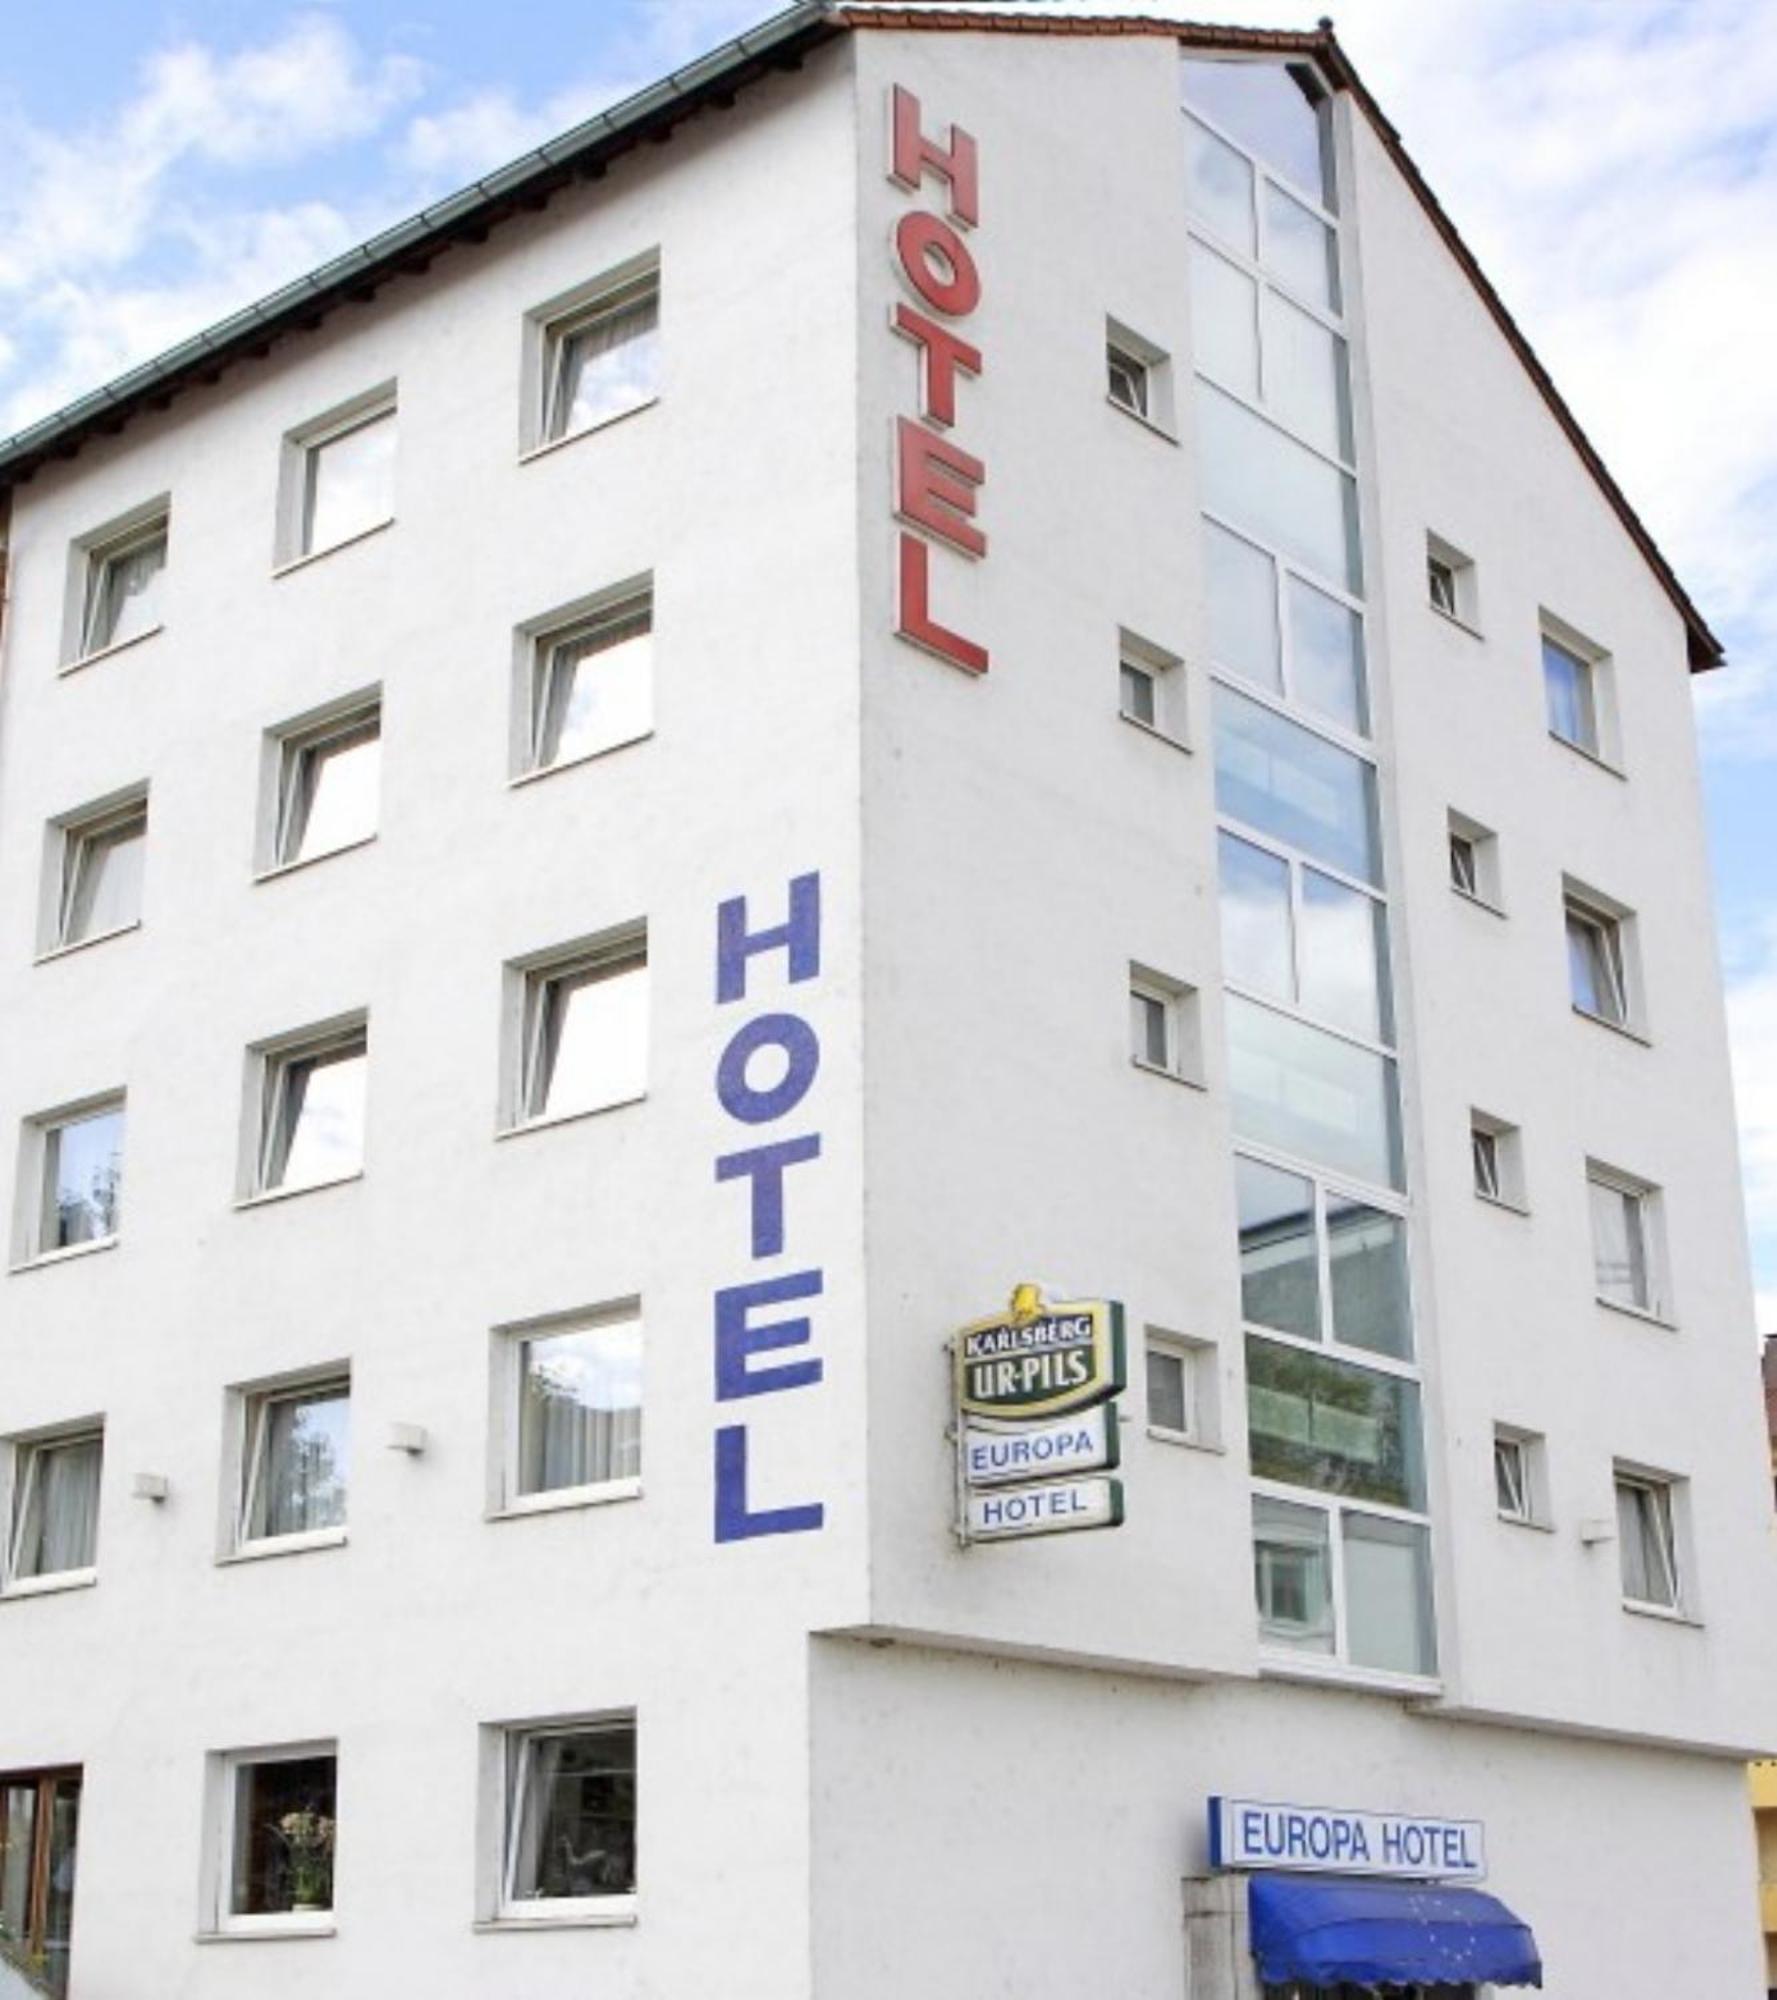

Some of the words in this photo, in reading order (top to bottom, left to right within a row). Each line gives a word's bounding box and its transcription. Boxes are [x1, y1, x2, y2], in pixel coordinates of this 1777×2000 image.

[888, 83, 989, 677] HOTEL
[714, 870, 823, 1543] HOTEL
[966, 1316, 1091, 1356] KARLSBERG
[973, 1350, 1088, 1398] UR-PILS
[971, 1431, 1094, 1470] EUROPA
[983, 1489, 1087, 1524] HOTEL
[1243, 1810, 1370, 1862] EUROPA
[1382, 1822, 1477, 1868] HOTEL
